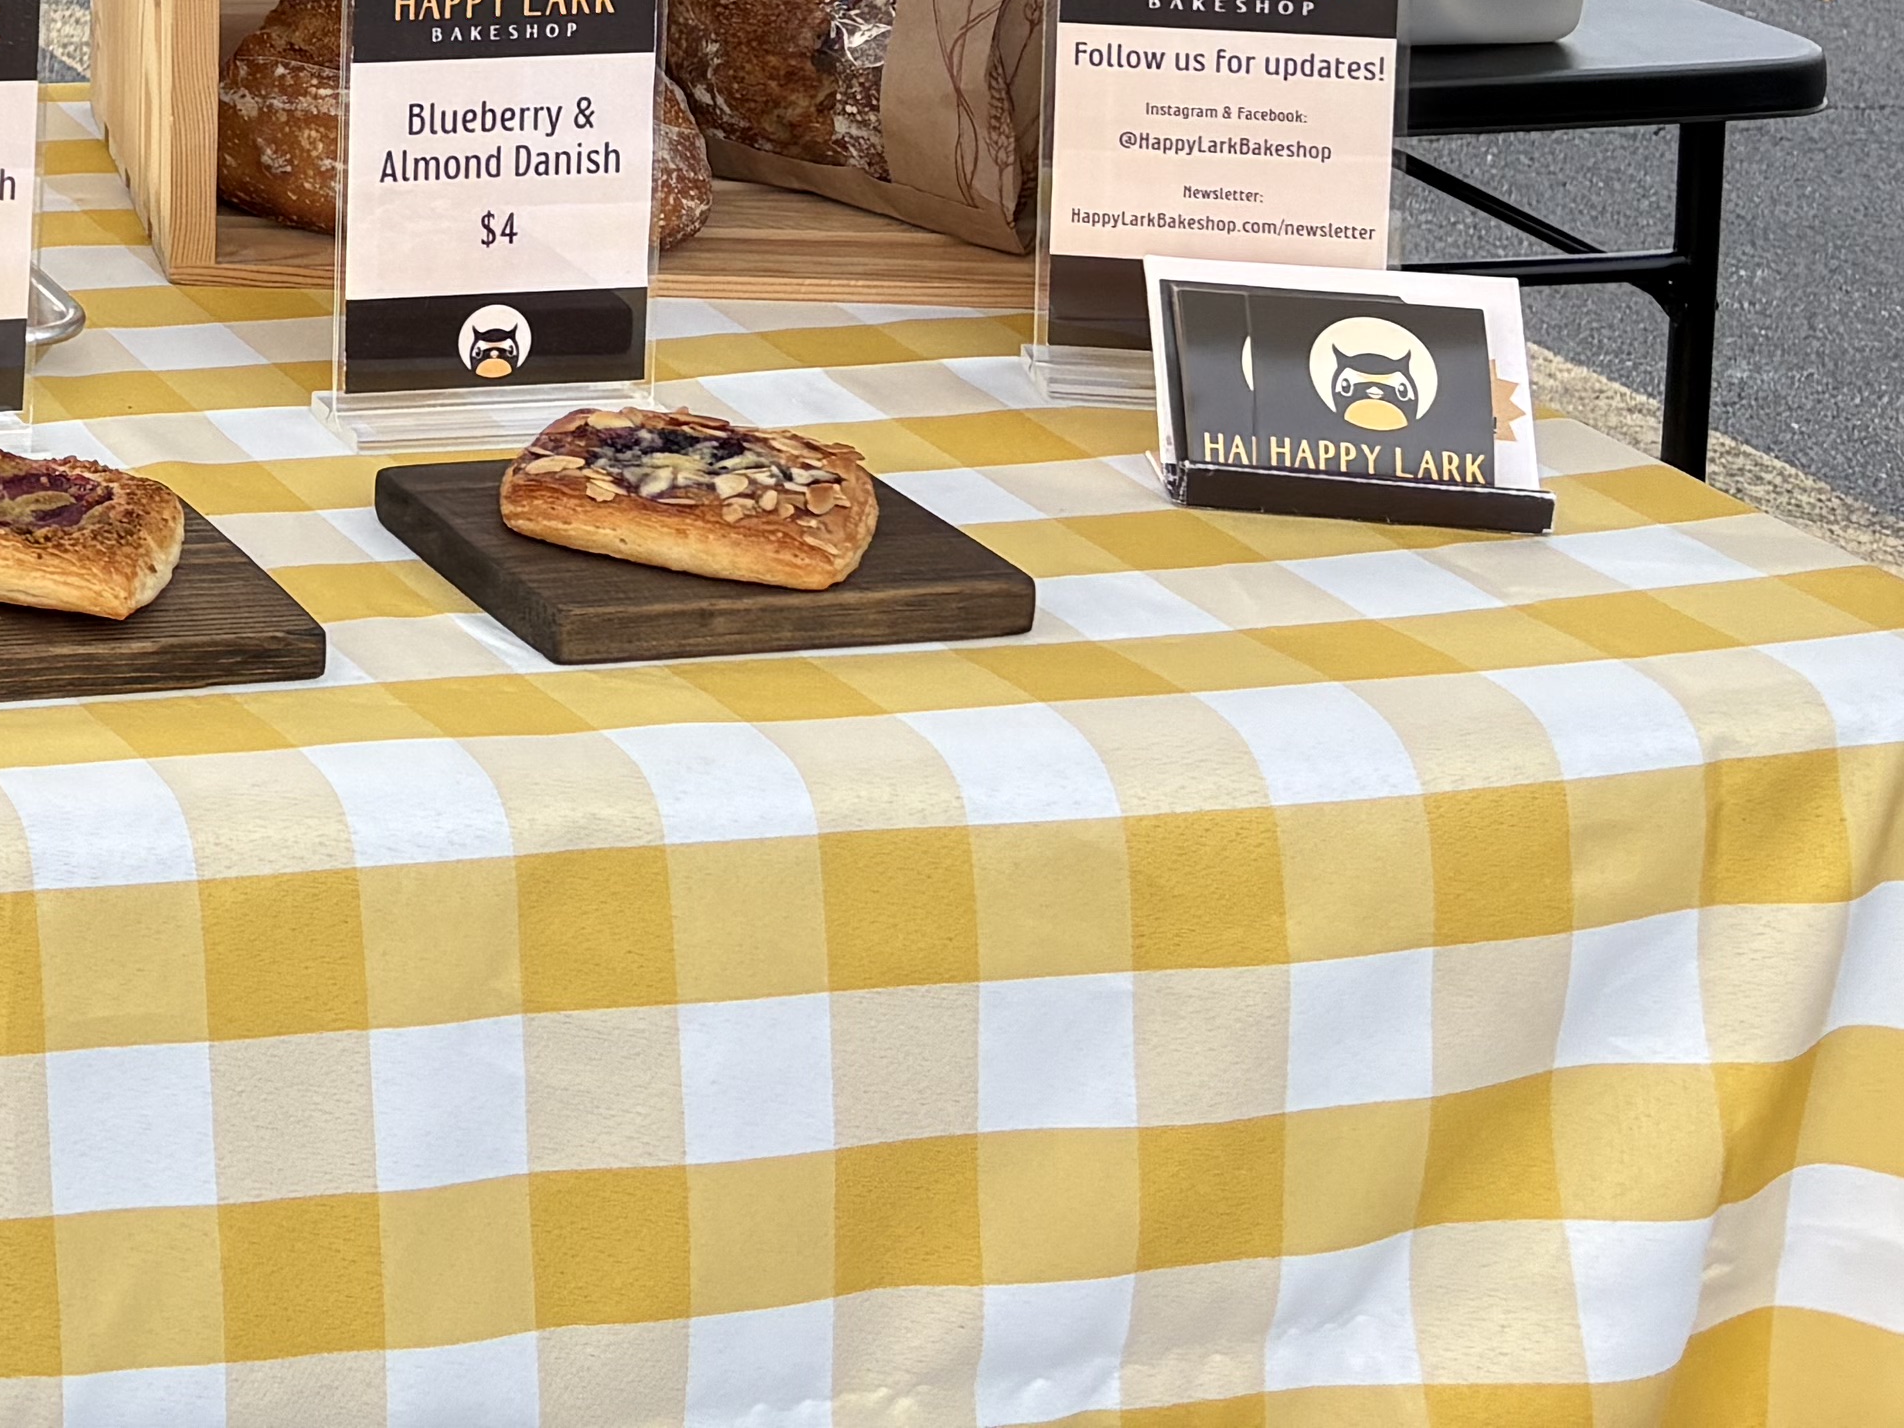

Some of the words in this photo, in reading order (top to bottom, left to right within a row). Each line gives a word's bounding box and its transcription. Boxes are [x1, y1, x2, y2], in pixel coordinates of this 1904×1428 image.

[431, 22, 577, 43] BAKESHOP
[1074, 41, 1166, 70] Follow
[1174, 52, 1206, 72] us
[1215, 48, 1256, 75] for
[1264, 52, 1385, 82] updates!
[408, 100, 563, 138] Blueberry
[573, 96, 595, 130] &
[1145, 101, 1218, 120] Instagram
[1221, 105, 1232, 120] &
[1237, 106, 1309, 123] Facebook:
[379, 145, 502, 184] Almond
[514, 141, 621, 177] Danish
[1118, 131, 1332, 164] @HappyLarkBakeshop
[1183, 185, 1264, 203] Newsletter:
[480, 209, 519, 249] $4
[1071, 207, 1376, 240] HappyLarkBakeshop.com/newsletter
[1269, 435, 1382, 475] HAPPY
[1394, 446, 1486, 485] LARK
